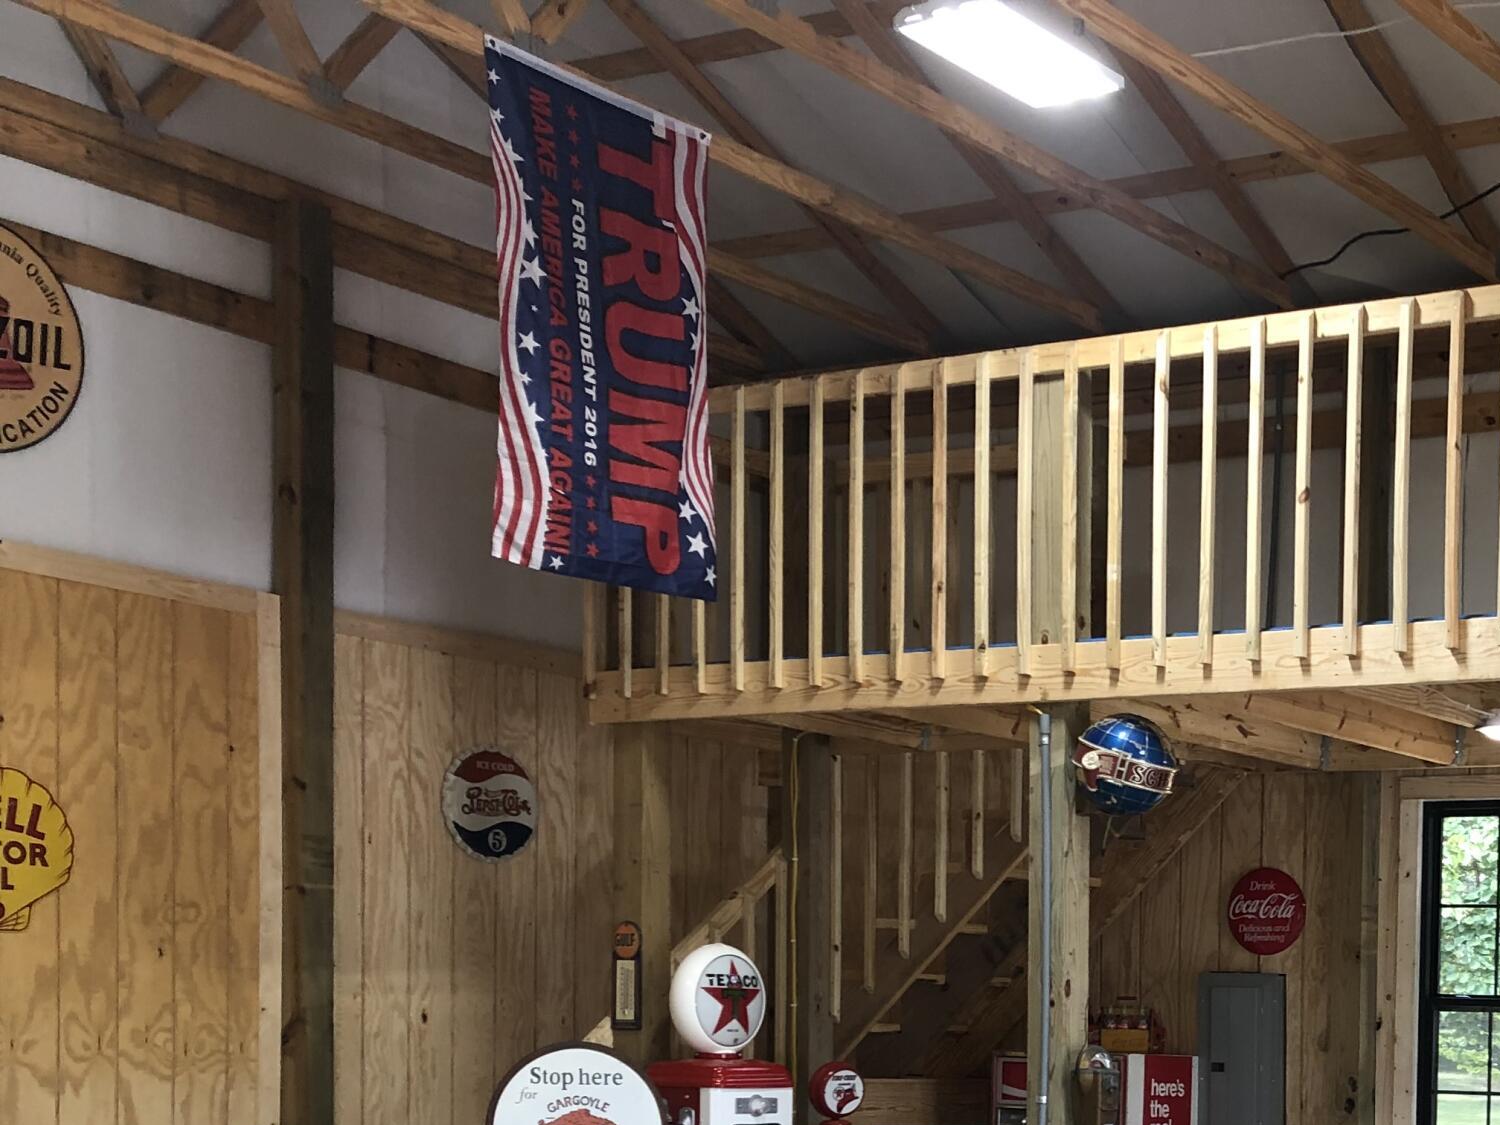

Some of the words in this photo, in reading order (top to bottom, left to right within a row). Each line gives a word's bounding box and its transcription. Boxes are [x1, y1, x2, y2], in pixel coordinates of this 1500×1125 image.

[528, 84, 559, 181] MAKE
[571, 198, 587, 255] FOR
[540, 186, 569, 326] AMERICA
[26, 263, 63, 316] Quality
[573, 256, 597, 402] PRESIDENT
[597, 141, 688, 576] TRUMP
[549, 337, 573, 442] GREAT
[584, 405, 598, 467] 2016
[544, 448, 574, 555] AGAIN!
[0, 796, 46, 841] LL
[0, 840, 49, 868] OR
[1249, 880, 1277, 891] Drink
[1229, 893, 1299, 920] Coca-Cola
[1243, 932, 1285, 943] Refreshing
[1272, 919, 1290, 932] and
[705, 973, 758, 988] TEXACO
[530, 1067, 574, 1090] Stop
[578, 1068, 624, 1086] here
[1151, 1079, 1186, 1098] here's
[515, 1087, 538, 1104] for
[547, 1095, 610, 1113] GARGOYLE
[1149, 1100, 1170, 1118] the
